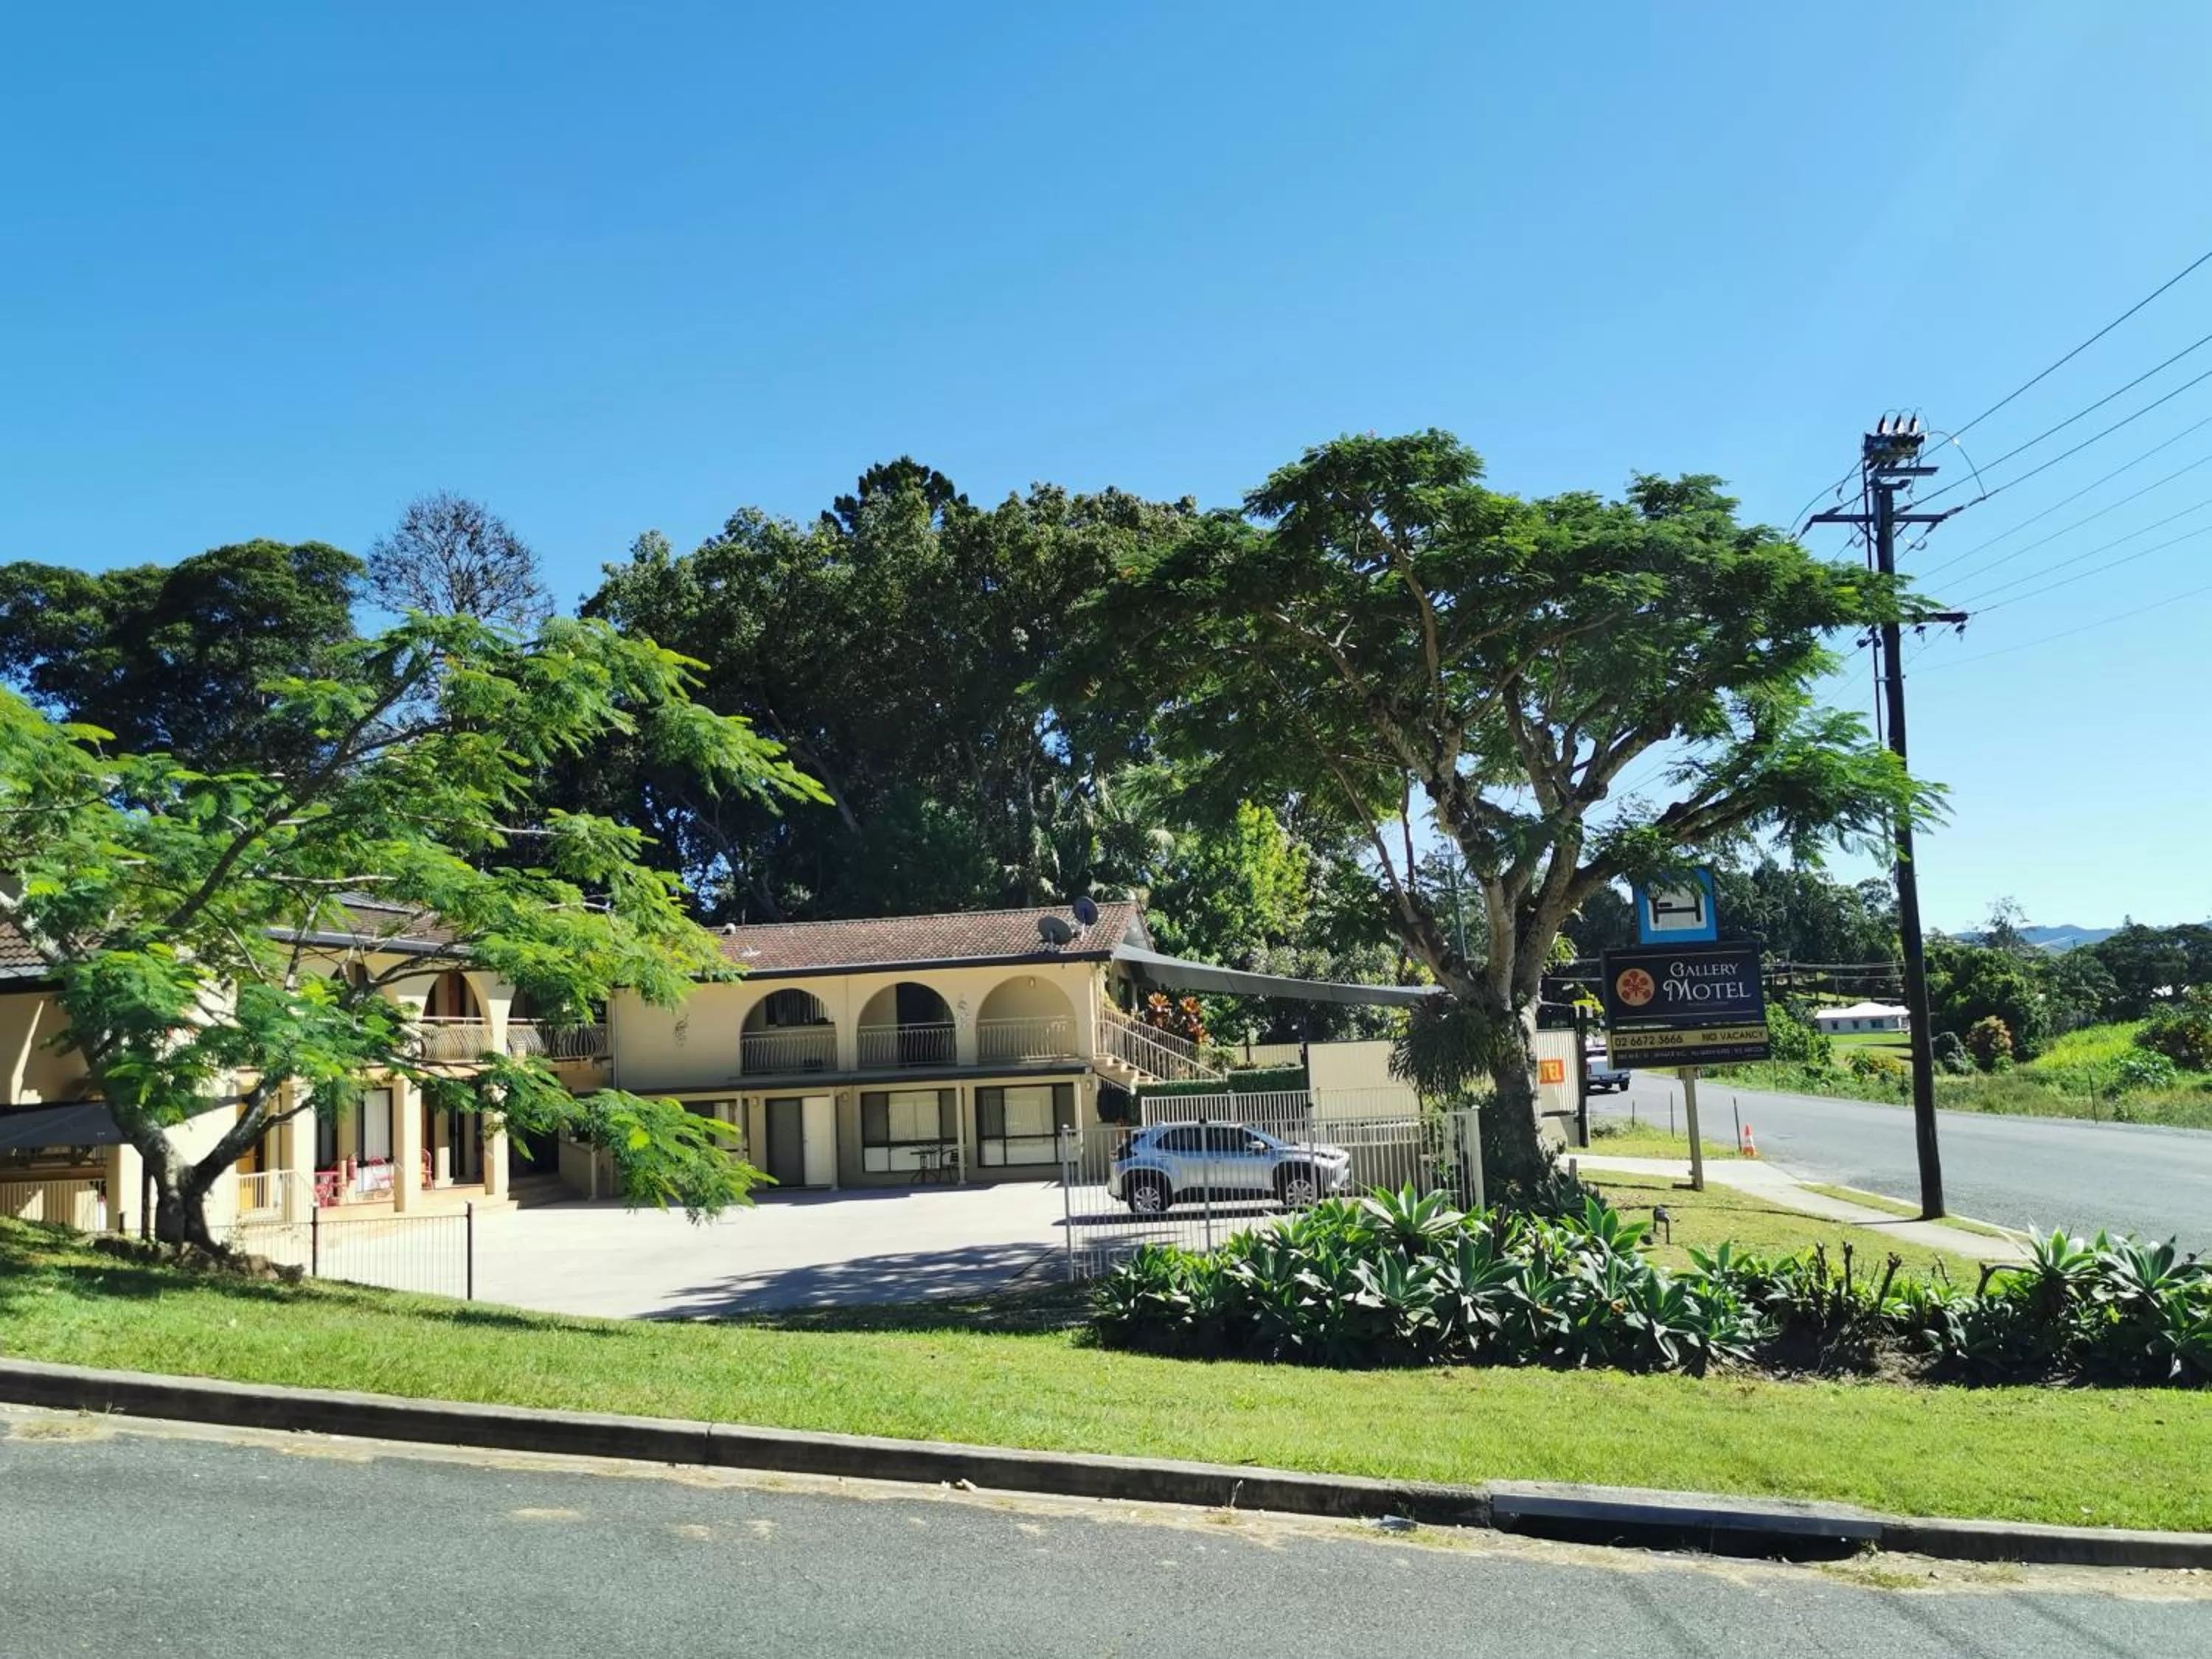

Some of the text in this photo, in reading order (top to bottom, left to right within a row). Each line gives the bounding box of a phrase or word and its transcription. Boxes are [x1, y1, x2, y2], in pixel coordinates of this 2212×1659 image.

[1670, 962, 1738, 978] GALLERY
[1663, 978, 1751, 1001] MOTEL
[1615, 1030, 1763, 1047] 02 6672 3666 NO VACANCY
